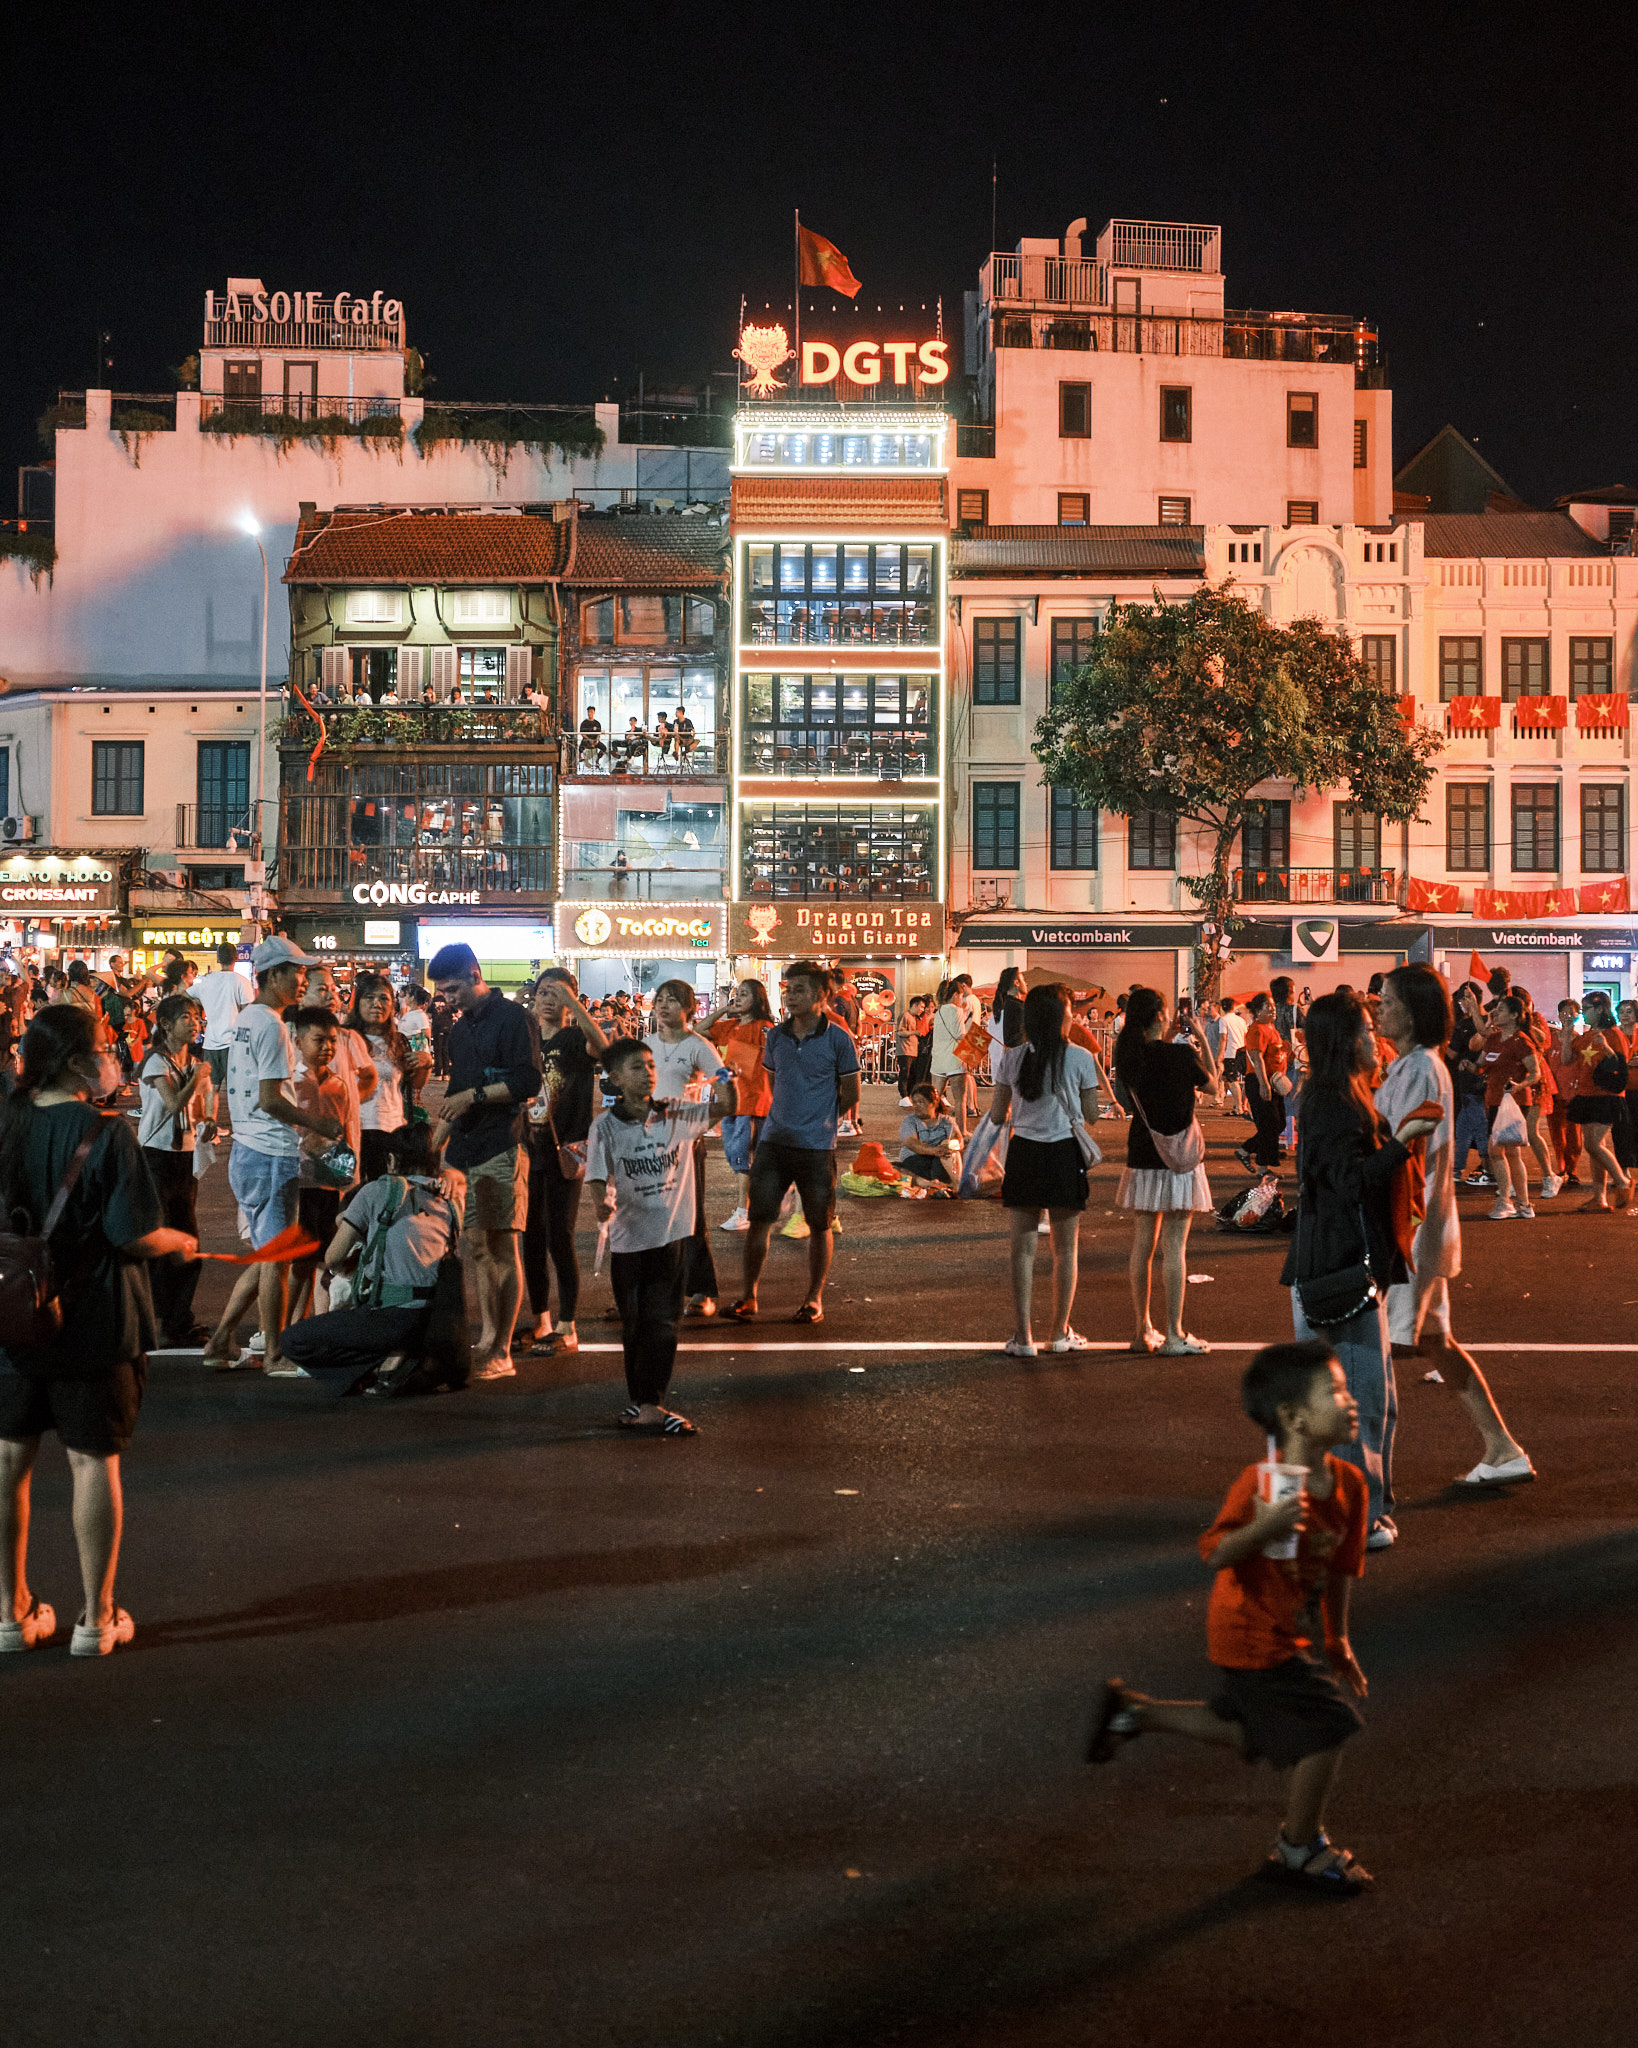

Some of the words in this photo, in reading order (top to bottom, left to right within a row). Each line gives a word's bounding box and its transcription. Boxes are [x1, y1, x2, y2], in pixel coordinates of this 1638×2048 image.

[205, 290, 243, 323] LA
[252, 290, 323, 324] SOIE
[333, 290, 401, 326] Cafe
[801, 340, 949, 385] DGTS
[56, 870, 112, 883] CHOCO
[1, 887, 99, 901] CROISSANT
[352, 879, 427, 908] CỘNG
[796, 908, 884, 930] Dragon
[891, 908, 932, 927] Tea
[142, 930, 187, 945] PATE
[188, 926, 224, 948] CỘT
[312, 935, 338, 950] 116
[691, 938, 709, 947] Tea
[812, 929, 857, 945] Suoi
[863, 929, 918, 947] Giang
[1031, 929, 1131, 943] Vietcombank
[1491, 931, 1583, 946] Vietcombank
[1591, 955, 1624, 969] ATM
